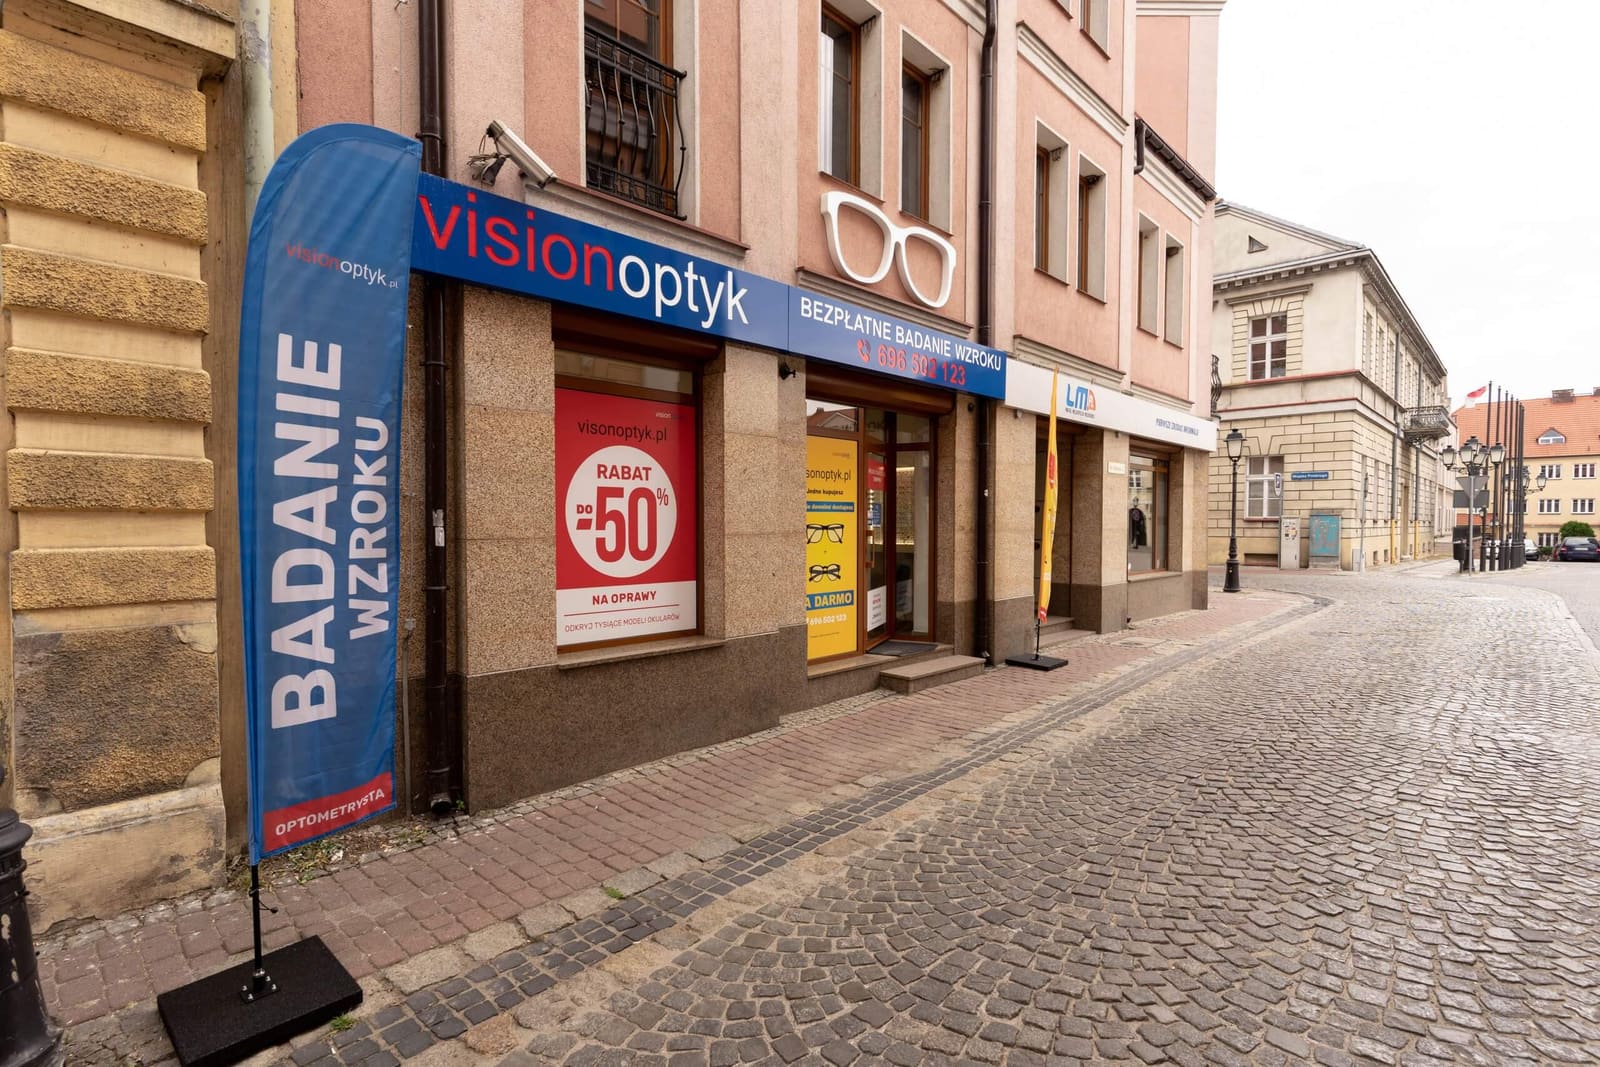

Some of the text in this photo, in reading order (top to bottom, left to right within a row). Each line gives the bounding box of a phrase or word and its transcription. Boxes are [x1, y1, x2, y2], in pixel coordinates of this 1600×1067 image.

[418, 192, 748, 329] visionoptyk
[800, 296, 1002, 371] BEZPŁATNE BADANIE WZROKU
[877, 343, 966, 385] 696 502 123
[577, 420, 668, 444] visonoptyk.pl
[597, 463, 652, 481] RABAT
[806, 469, 851, 483] sonoptyk.pl
[576, 504, 593, 514] DO
[271, 333, 342, 730] BADANIE
[348, 416, 390, 640] WZROKU
[592, 591, 657, 606] NA OPRAWY
[814, 592, 852, 607] DARMO
[565, 622, 593, 633] ODKRYJ
[595, 619, 622, 629] TYSIĄCE
[274, 787, 385, 837] OPTOMETRYSTA
